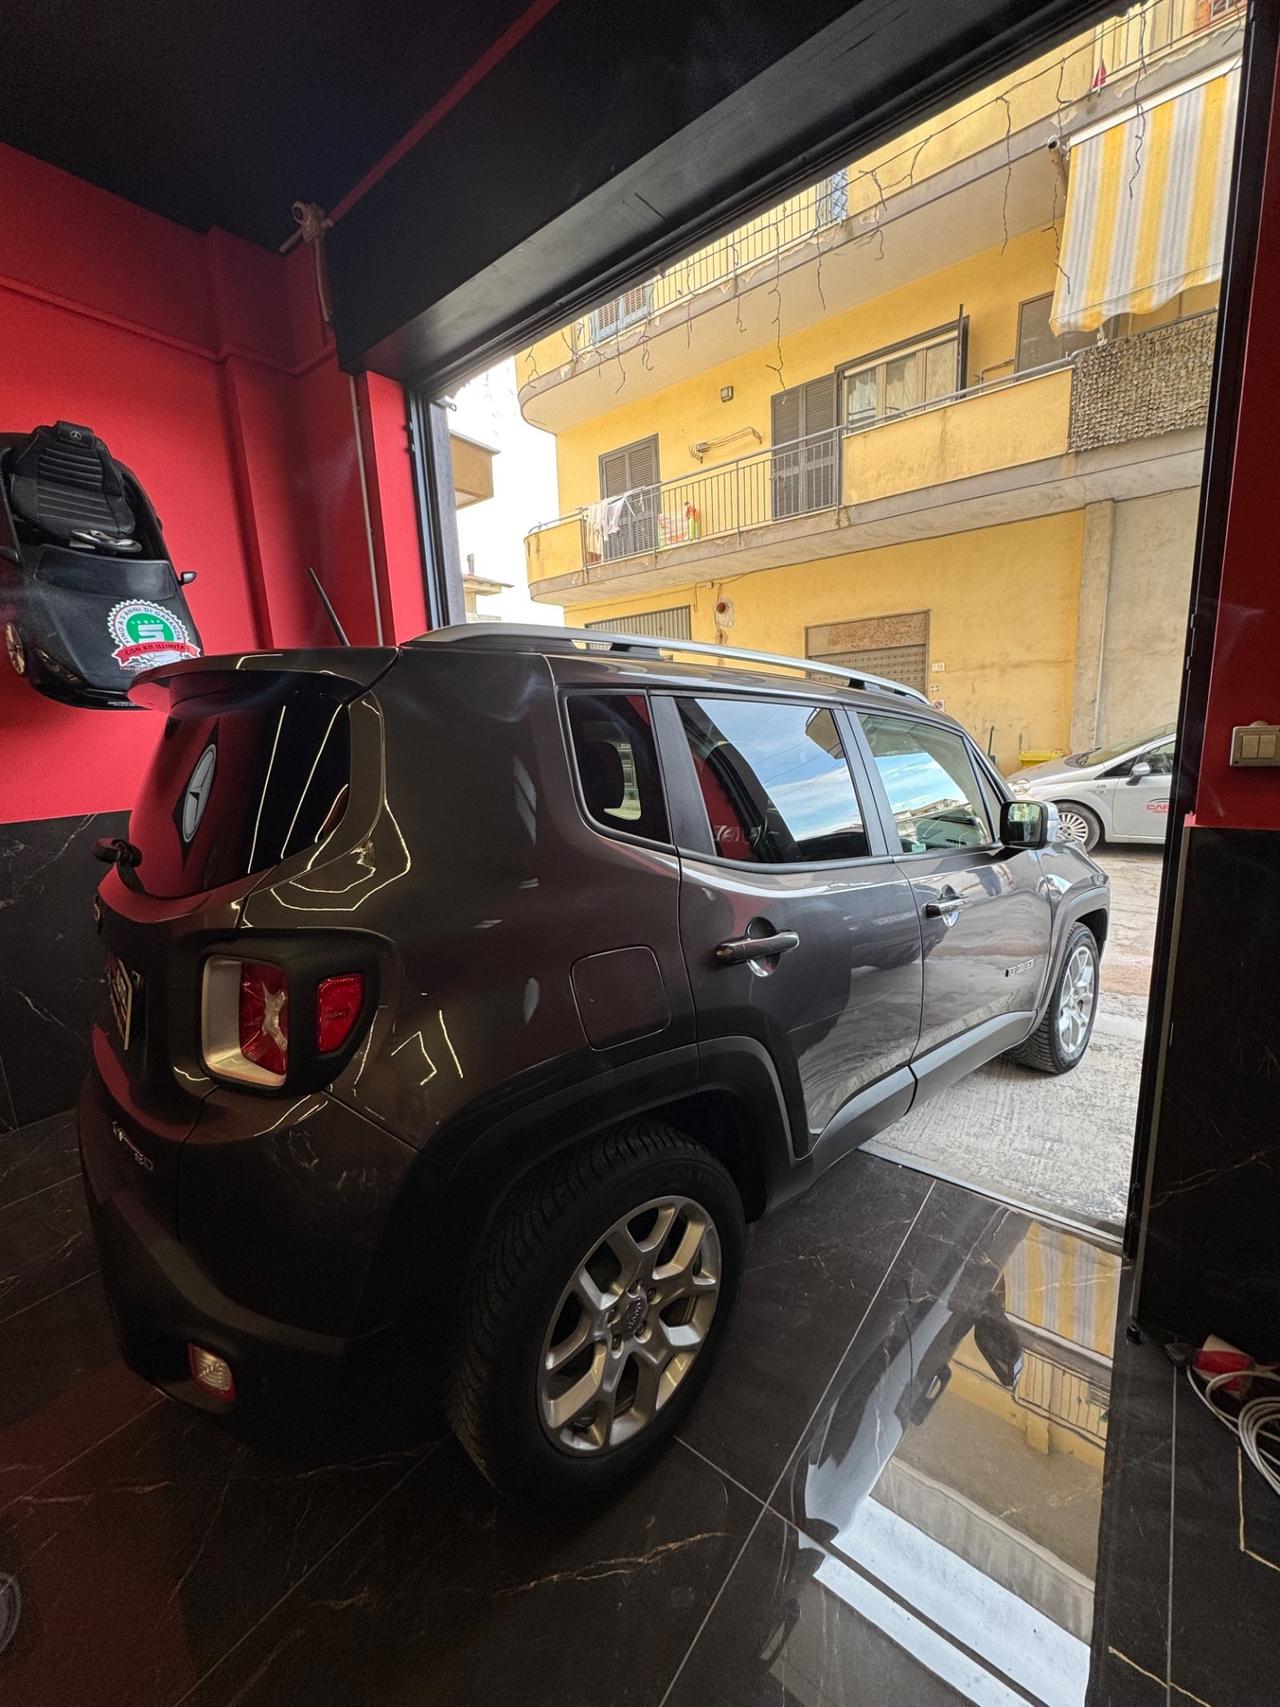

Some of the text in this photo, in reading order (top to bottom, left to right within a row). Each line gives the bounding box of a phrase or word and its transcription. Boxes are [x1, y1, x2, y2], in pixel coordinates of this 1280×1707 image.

[118, 628, 131, 644] FINO
[125, 607, 142, 615] ANNI
[155, 611, 182, 640] GARANZIA
[125, 645, 142, 656] CON
